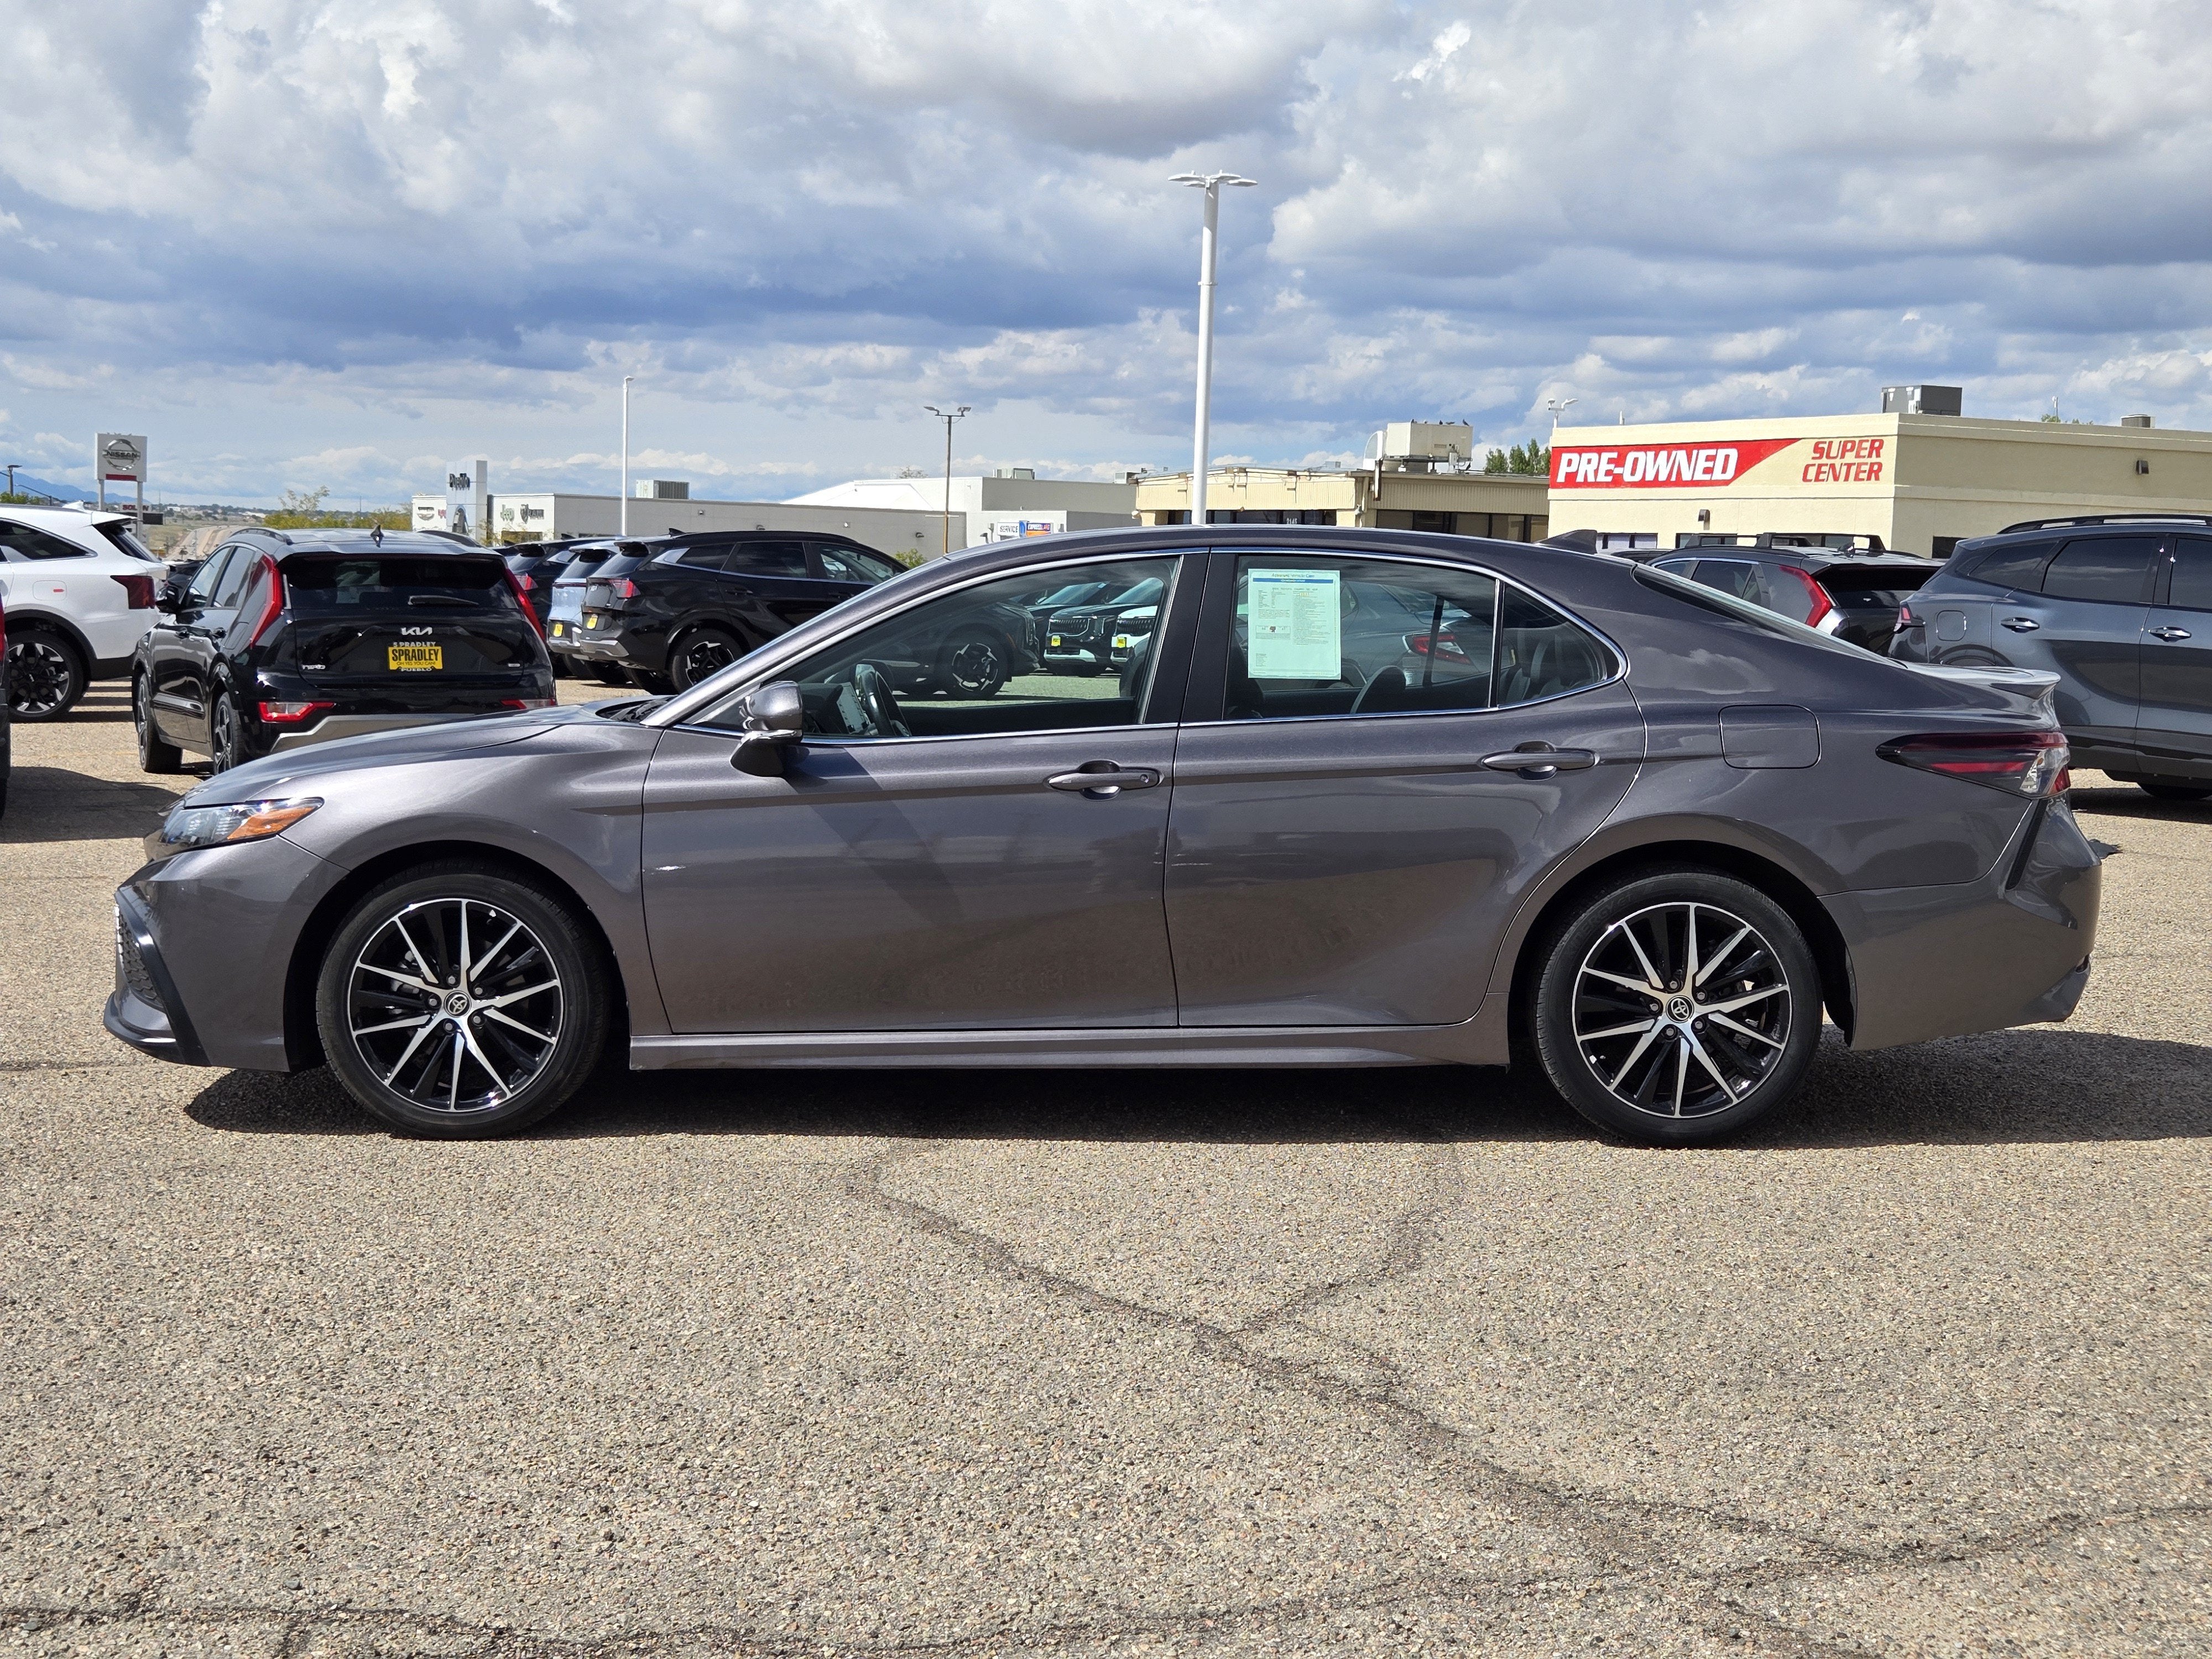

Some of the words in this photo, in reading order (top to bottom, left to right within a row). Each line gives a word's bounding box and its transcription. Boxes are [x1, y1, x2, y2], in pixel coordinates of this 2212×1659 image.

[1811, 439, 1884, 460] SUPER
[1556, 448, 1738, 483] PRE-OWNED
[1802, 462, 1883, 483] CENTER
[392, 649, 439, 661] SPRADLEY
